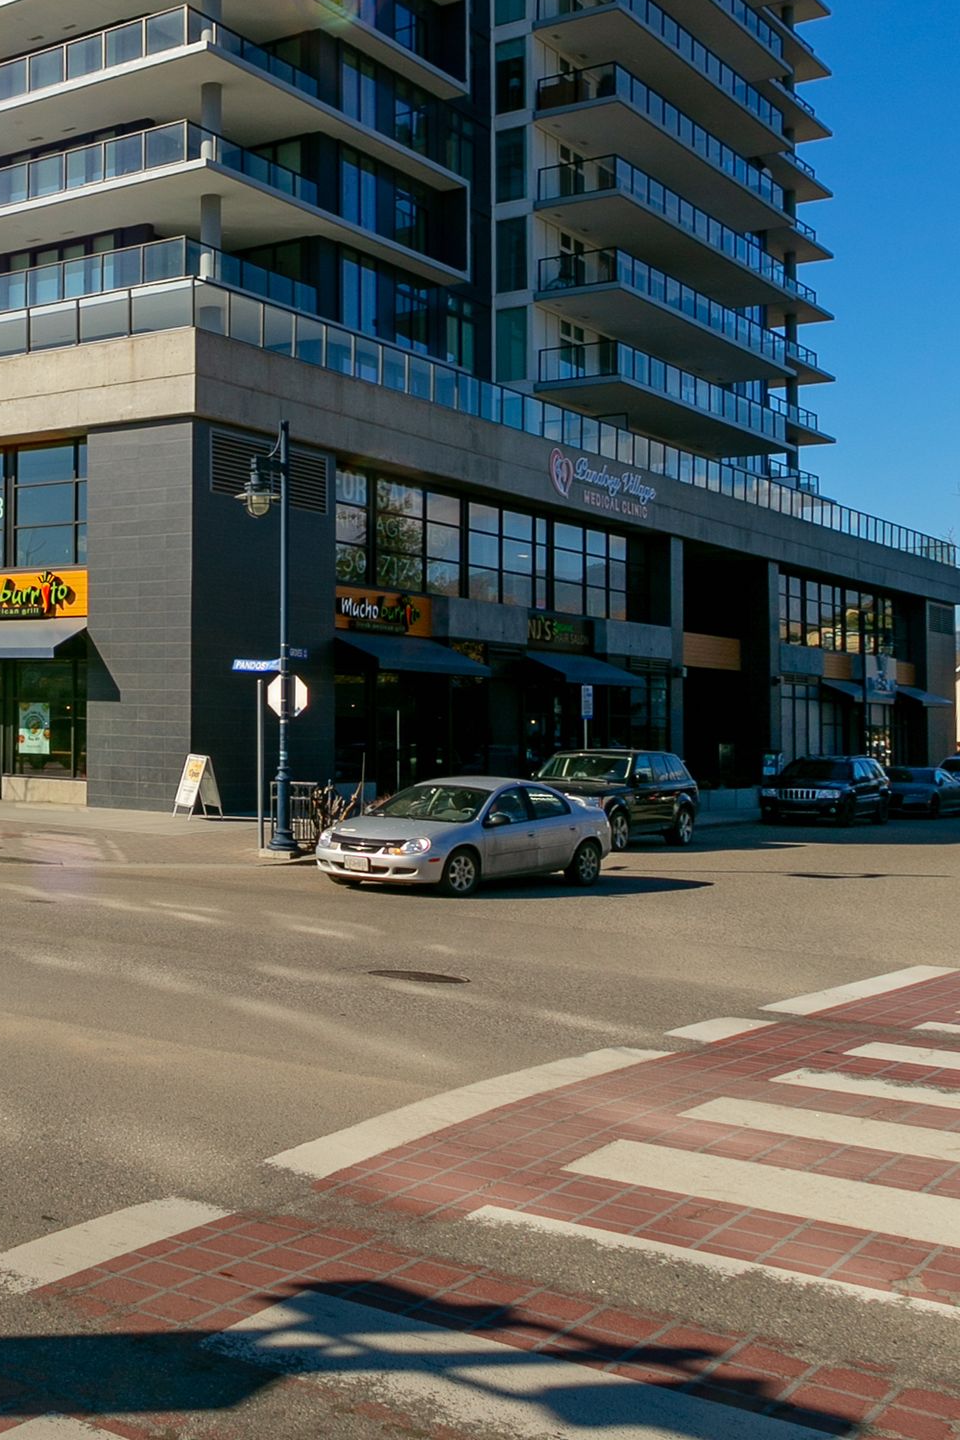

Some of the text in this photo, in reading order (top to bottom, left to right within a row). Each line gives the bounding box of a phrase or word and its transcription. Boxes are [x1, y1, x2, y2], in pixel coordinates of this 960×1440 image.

[621, 472, 657, 505] Village
[583, 490, 648, 519] MEDICAL CLINIC
[22, 607, 39, 616] grill
